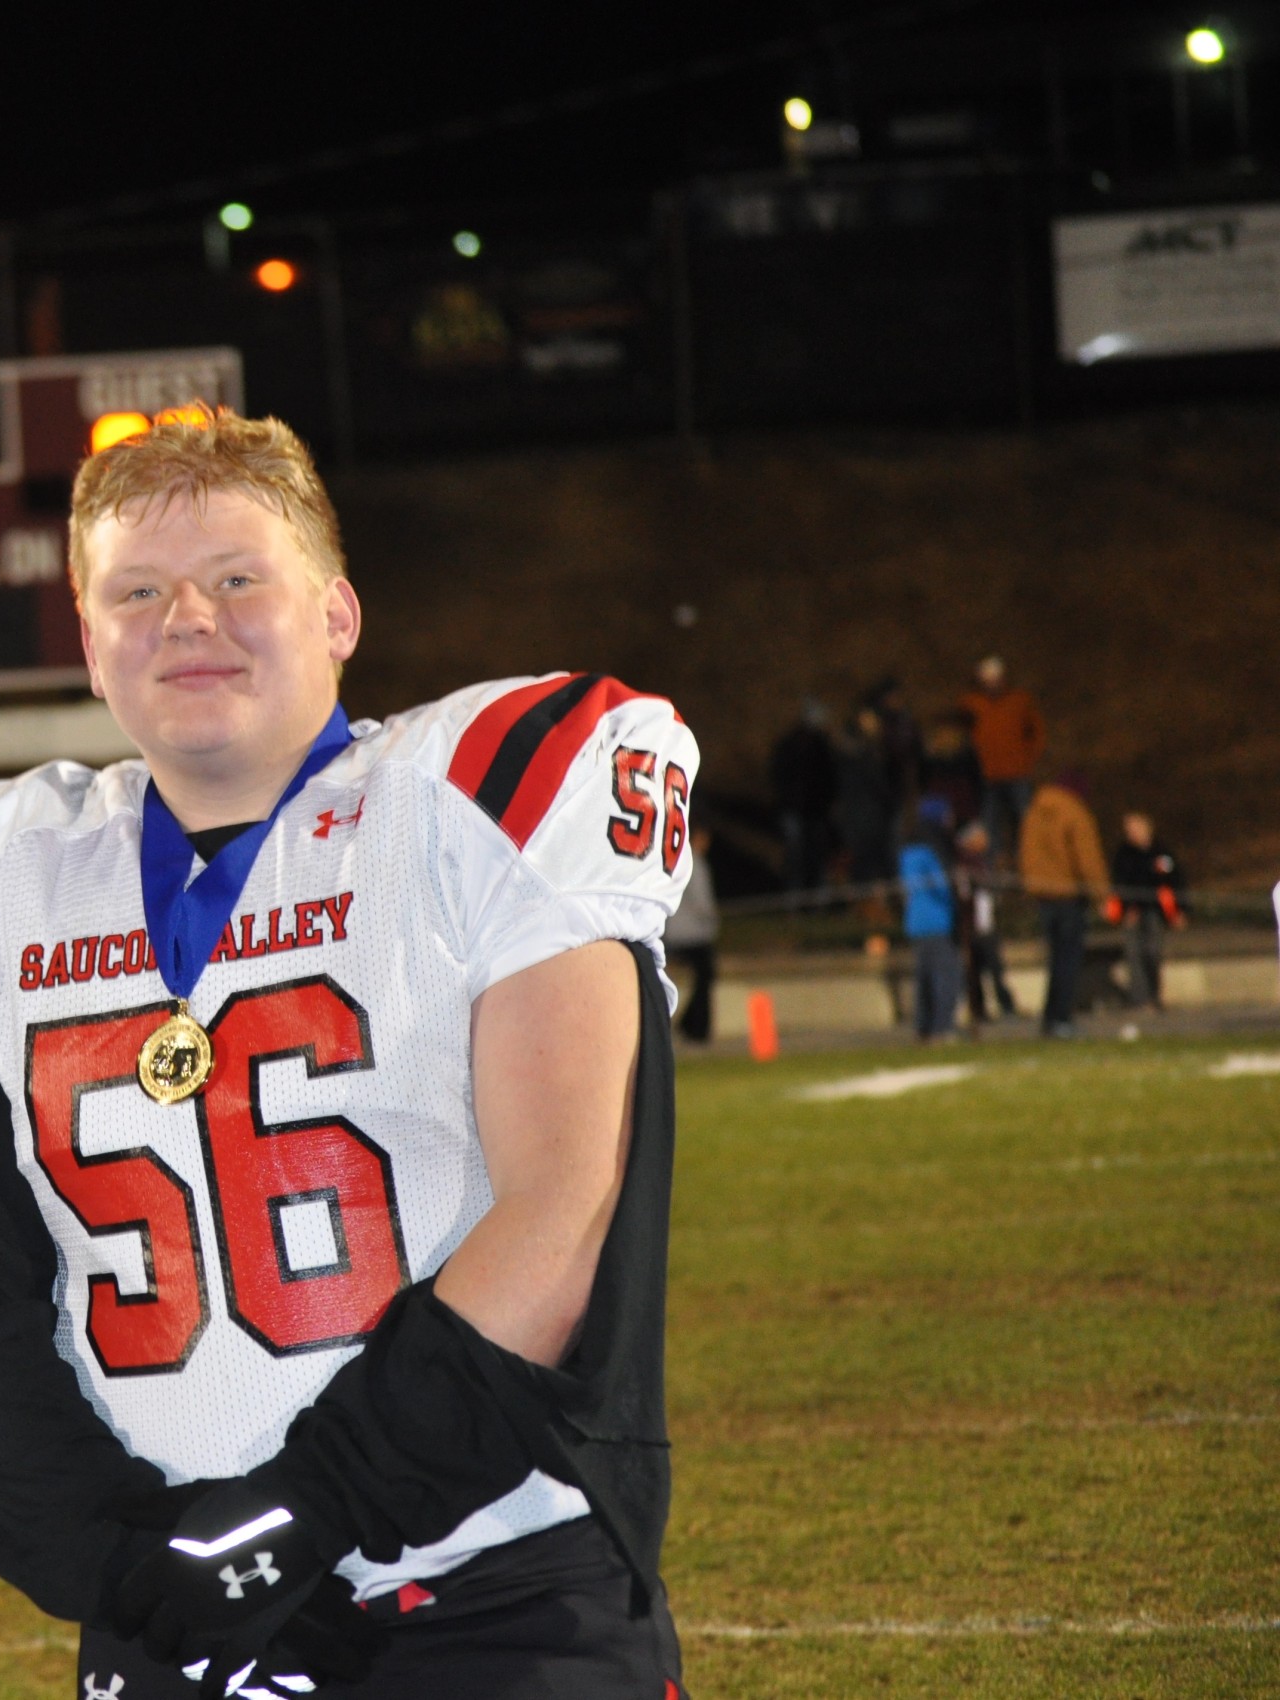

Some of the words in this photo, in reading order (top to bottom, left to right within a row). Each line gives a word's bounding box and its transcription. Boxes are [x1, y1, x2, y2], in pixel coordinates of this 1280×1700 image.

[607, 745, 689, 879] 56
[19, 928, 157, 992] SAUCO
[208, 890, 354, 964] ALLEY
[23, 972, 413, 1379] 56
